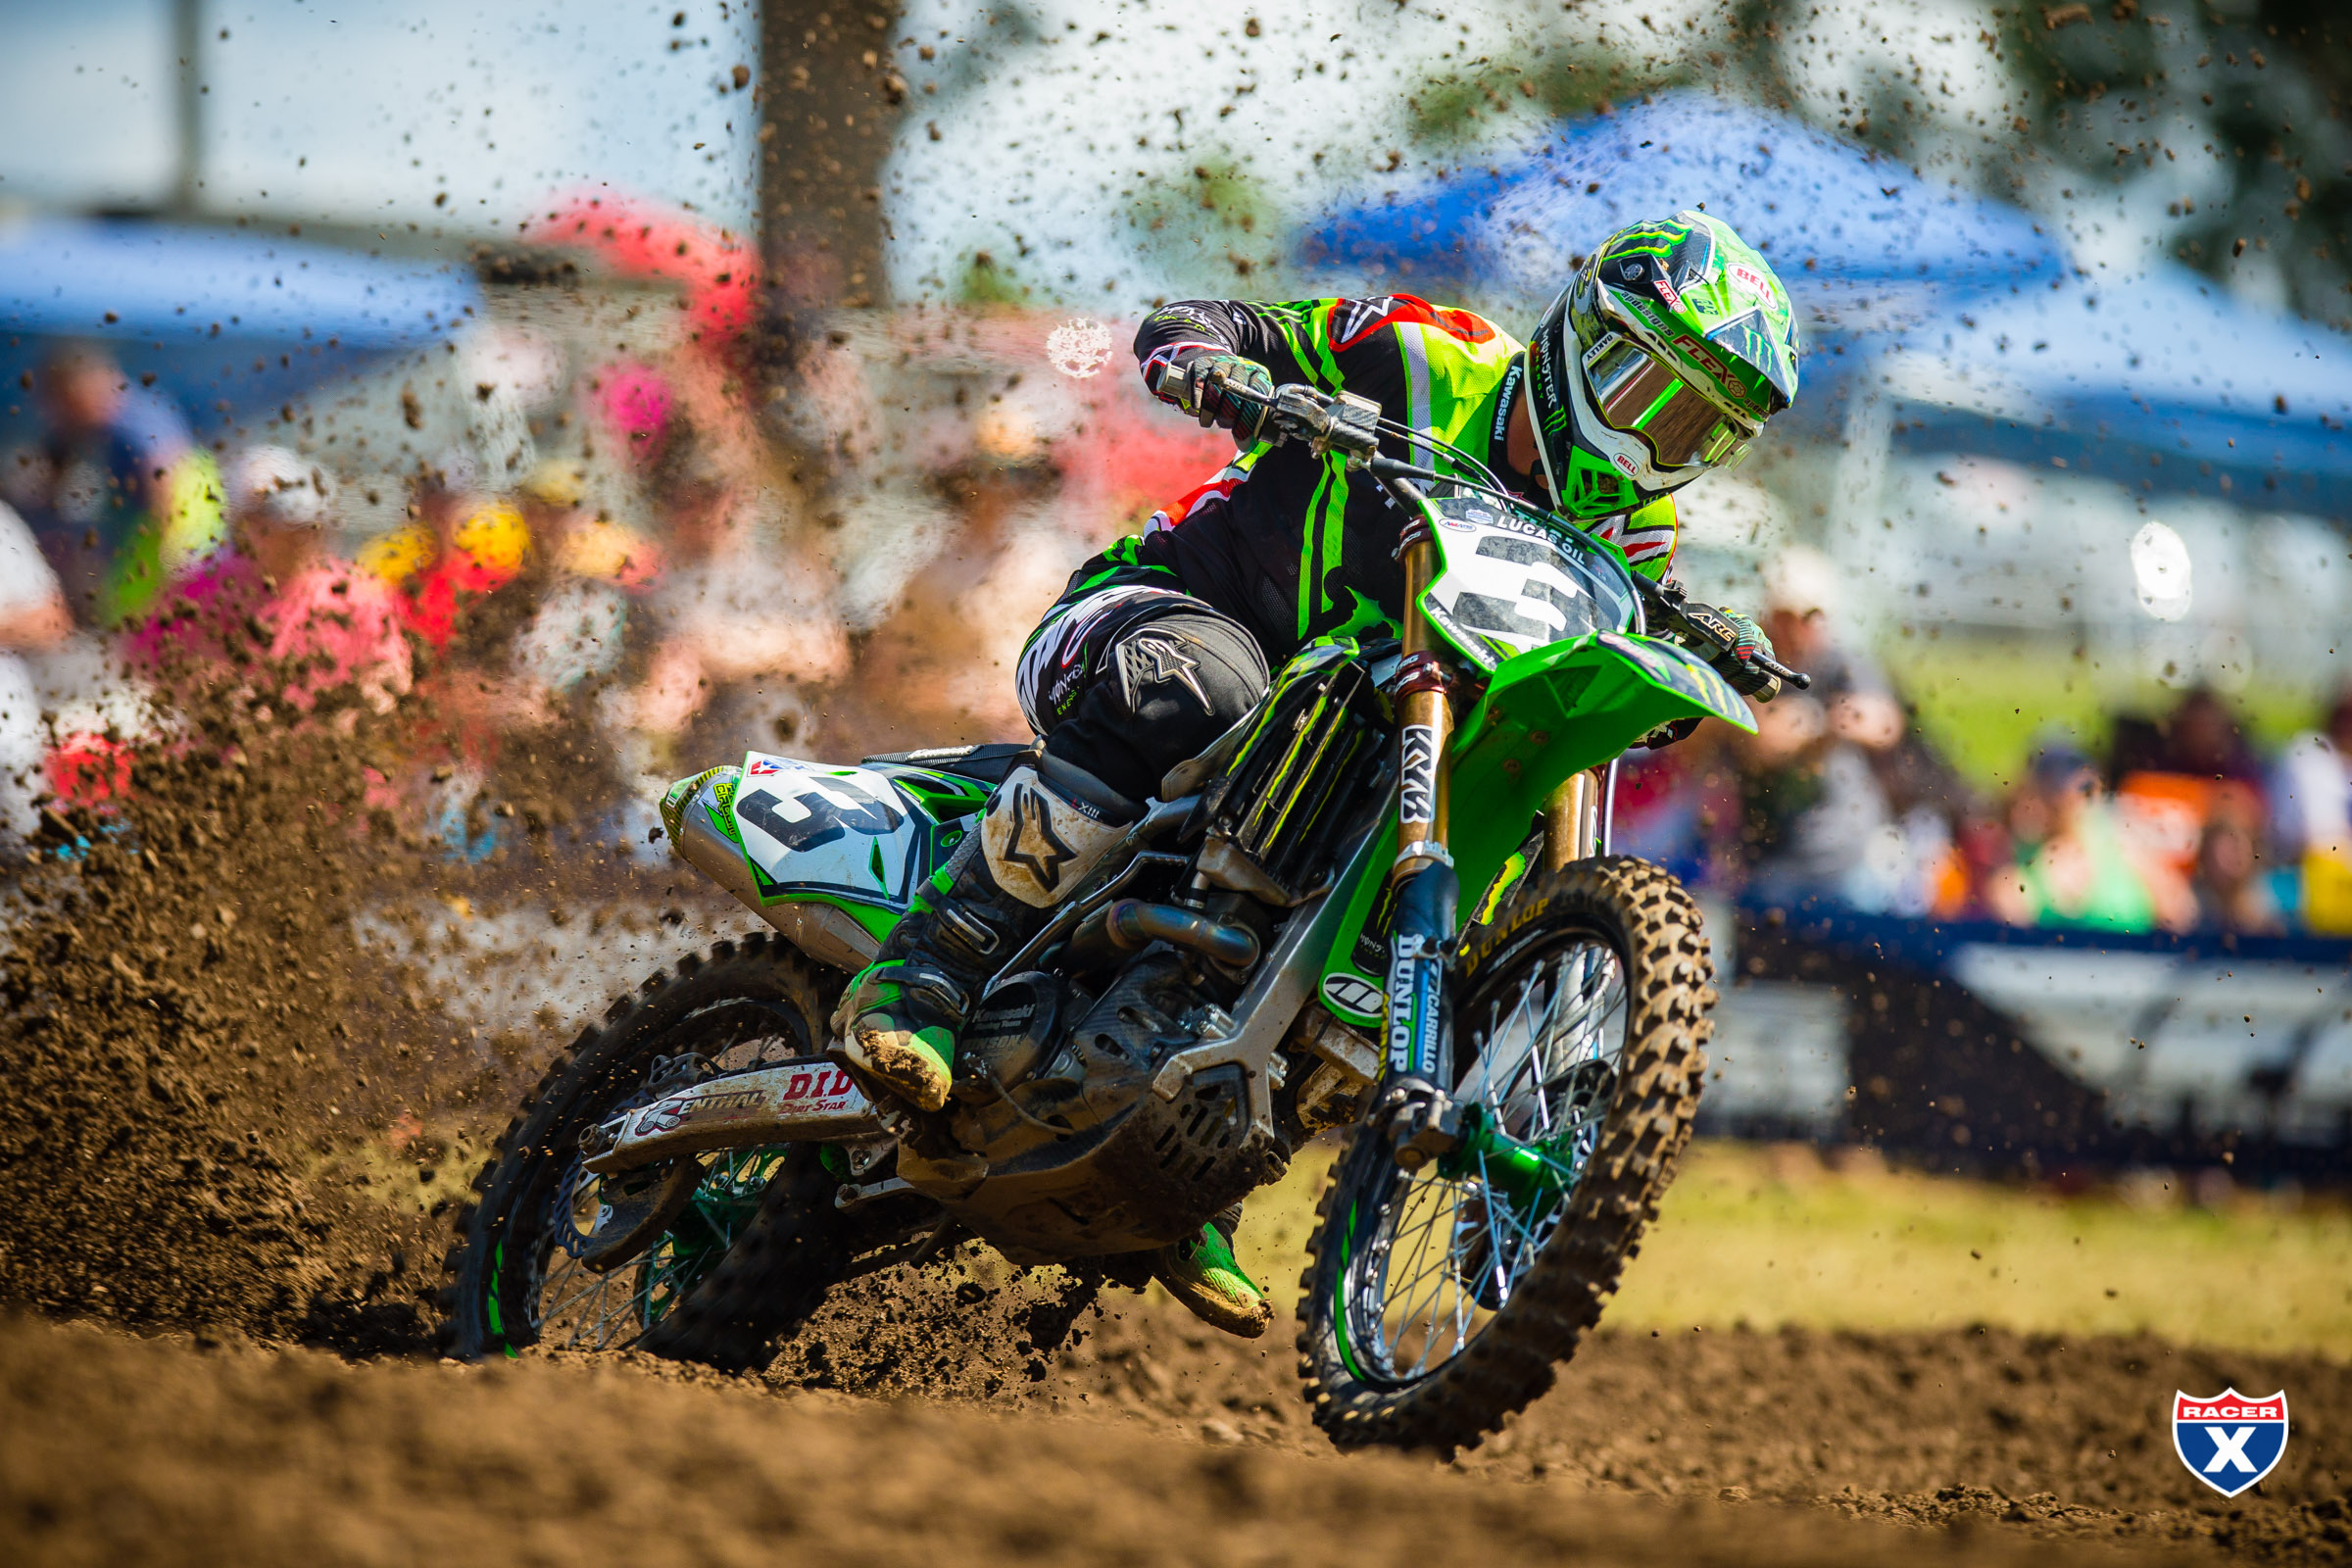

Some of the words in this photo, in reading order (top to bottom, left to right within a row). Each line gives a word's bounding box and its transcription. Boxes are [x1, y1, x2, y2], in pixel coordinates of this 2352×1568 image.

[1621, 292, 1676, 337] apdesigns
[1654, 280, 1681, 306] FLEX
[1736, 268, 1773, 304] BELL
[1540, 327, 1558, 409] MONSTER
[1586, 334, 1614, 362] OAKLEY
[1672, 334, 1736, 384] FLEX
[1494, 365, 1523, 442] Kawasaki
[1616, 454, 1638, 475] BELL
[1496, 515, 1557, 543] LUCAS
[1560, 542, 1587, 565] OIL
[1452, 535, 1615, 645] 3
[1429, 606, 1497, 672] Kawasaki
[1687, 612, 1737, 643] ARC
[736, 776, 905, 853] 3
[1465, 898, 1550, 979] DUNLOP
[1389, 933, 1420, 1074] DUNLOP
[1422, 993, 1442, 1074] CARRILLO
